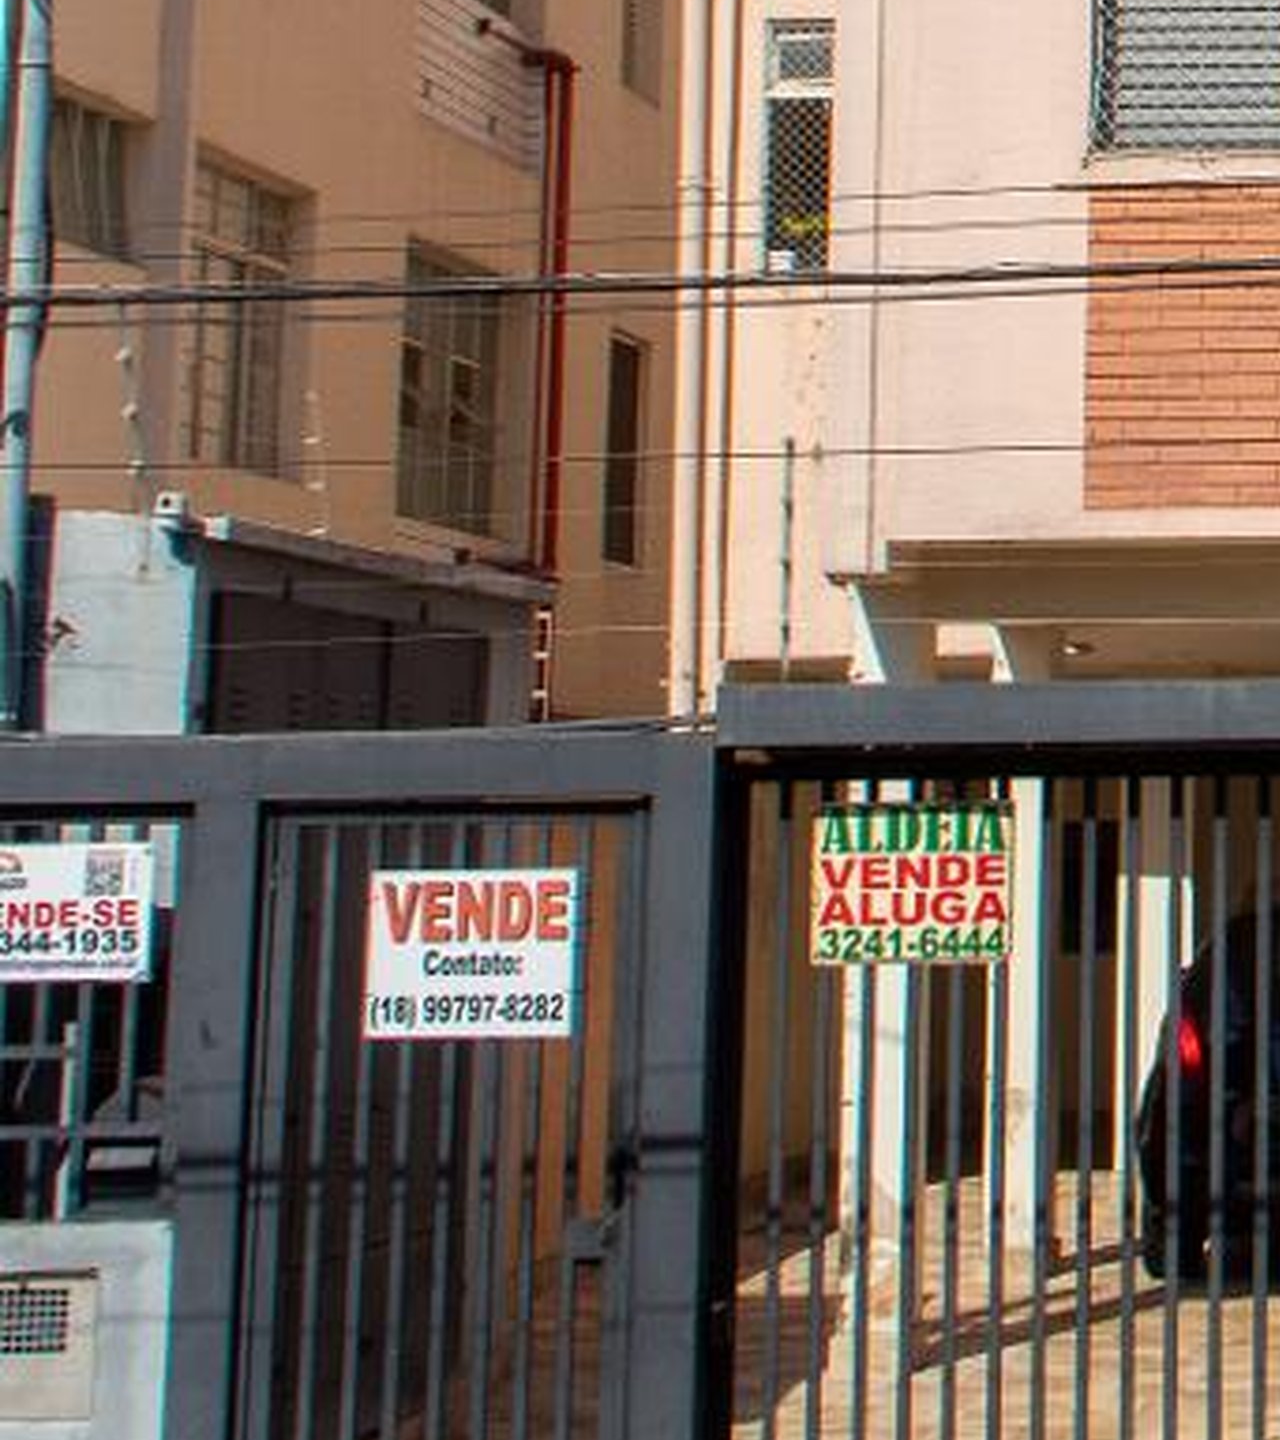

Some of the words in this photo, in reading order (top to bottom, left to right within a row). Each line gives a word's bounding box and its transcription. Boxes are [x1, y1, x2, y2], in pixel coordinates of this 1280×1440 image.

[822, 805, 1004, 852] ALDEIA
[822, 855, 1005, 889] VENDE
[0, 899, 139, 927] NDE-SE
[383, 880, 569, 944] VENDE
[818, 891, 1006, 926] ALUGA
[820, 927, 1003, 960] 3241-6444
[423, 951, 523, 975] Contato:
[371, 996, 417, 1028] (18)
[422, 994, 564, 1023] 99797-8282
